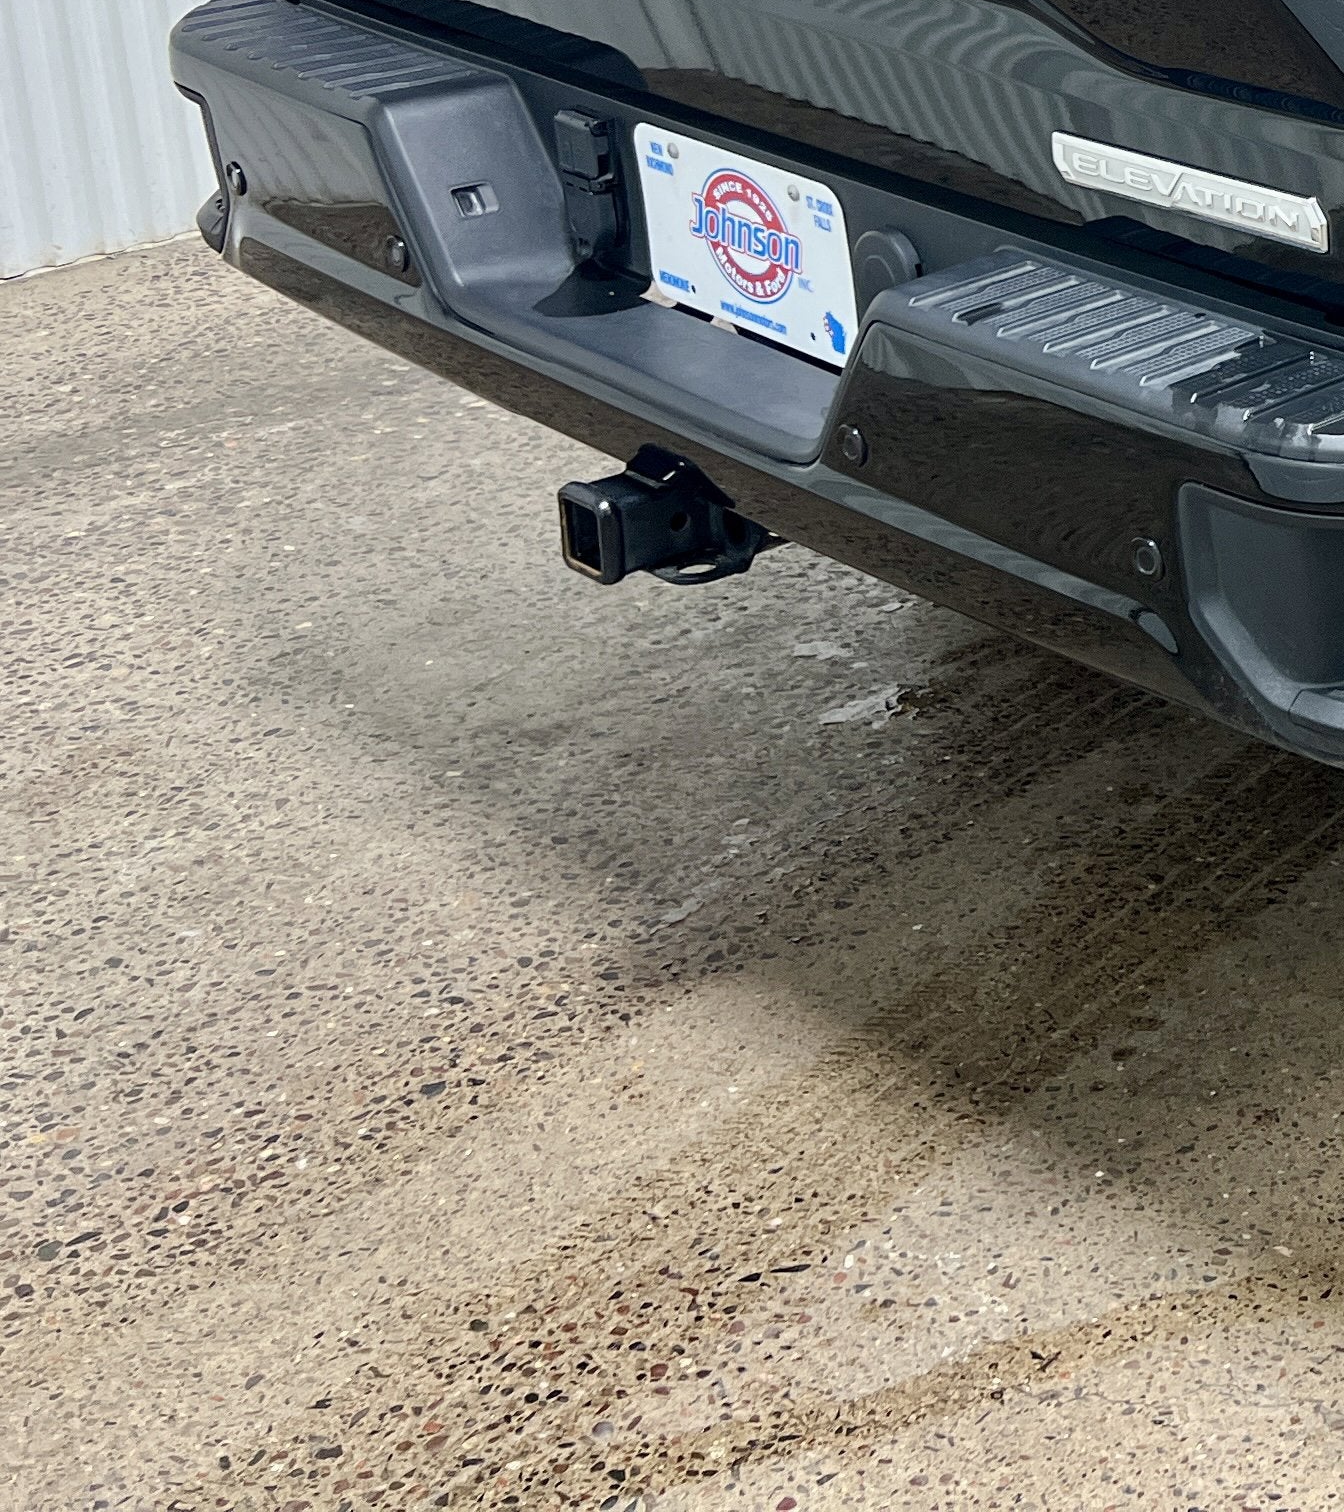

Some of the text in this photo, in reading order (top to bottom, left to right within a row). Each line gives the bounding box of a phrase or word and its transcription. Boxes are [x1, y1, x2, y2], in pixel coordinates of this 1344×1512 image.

[713, 180, 743, 200] SINCE
[1071, 150, 1301, 234] ELEVATION
[690, 194, 801, 272] Johnson
[715, 246, 786, 296] Motors & Ford
